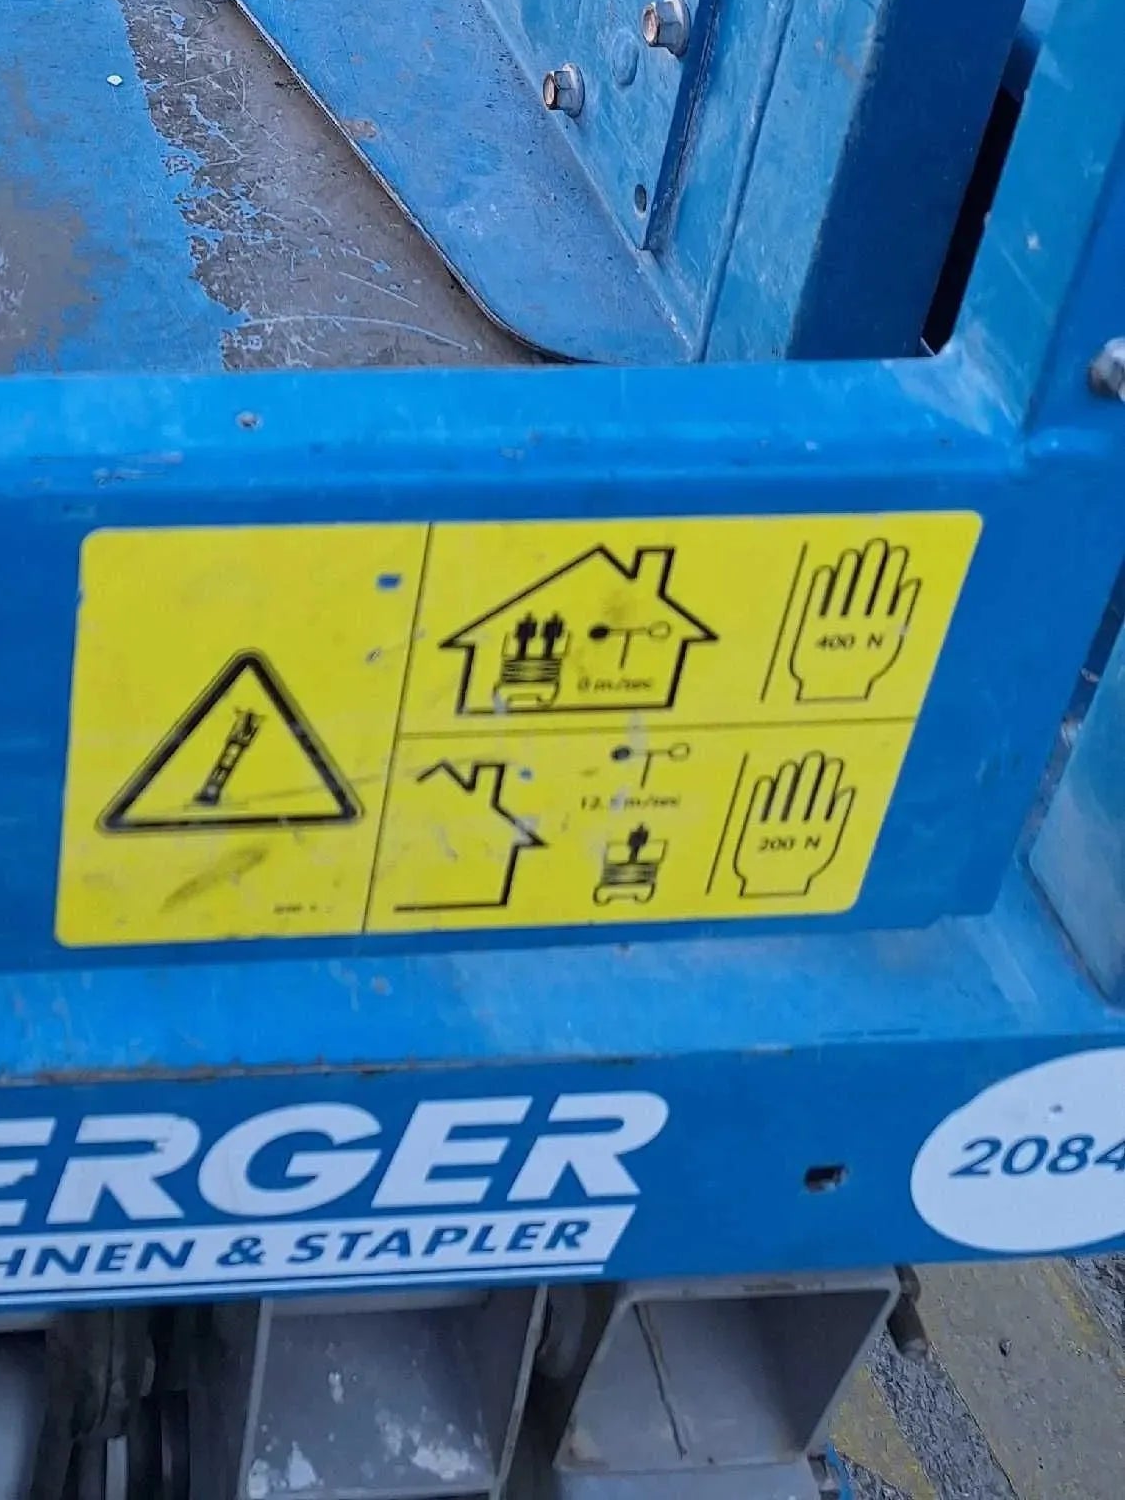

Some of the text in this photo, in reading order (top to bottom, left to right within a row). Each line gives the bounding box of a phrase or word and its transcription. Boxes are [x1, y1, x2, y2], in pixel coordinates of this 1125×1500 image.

[816, 631, 885, 651] 400 N
[803, 834, 822, 851] N
[217, 1236, 267, 1267] &
[287, 1219, 591, 1264] STAPLER
